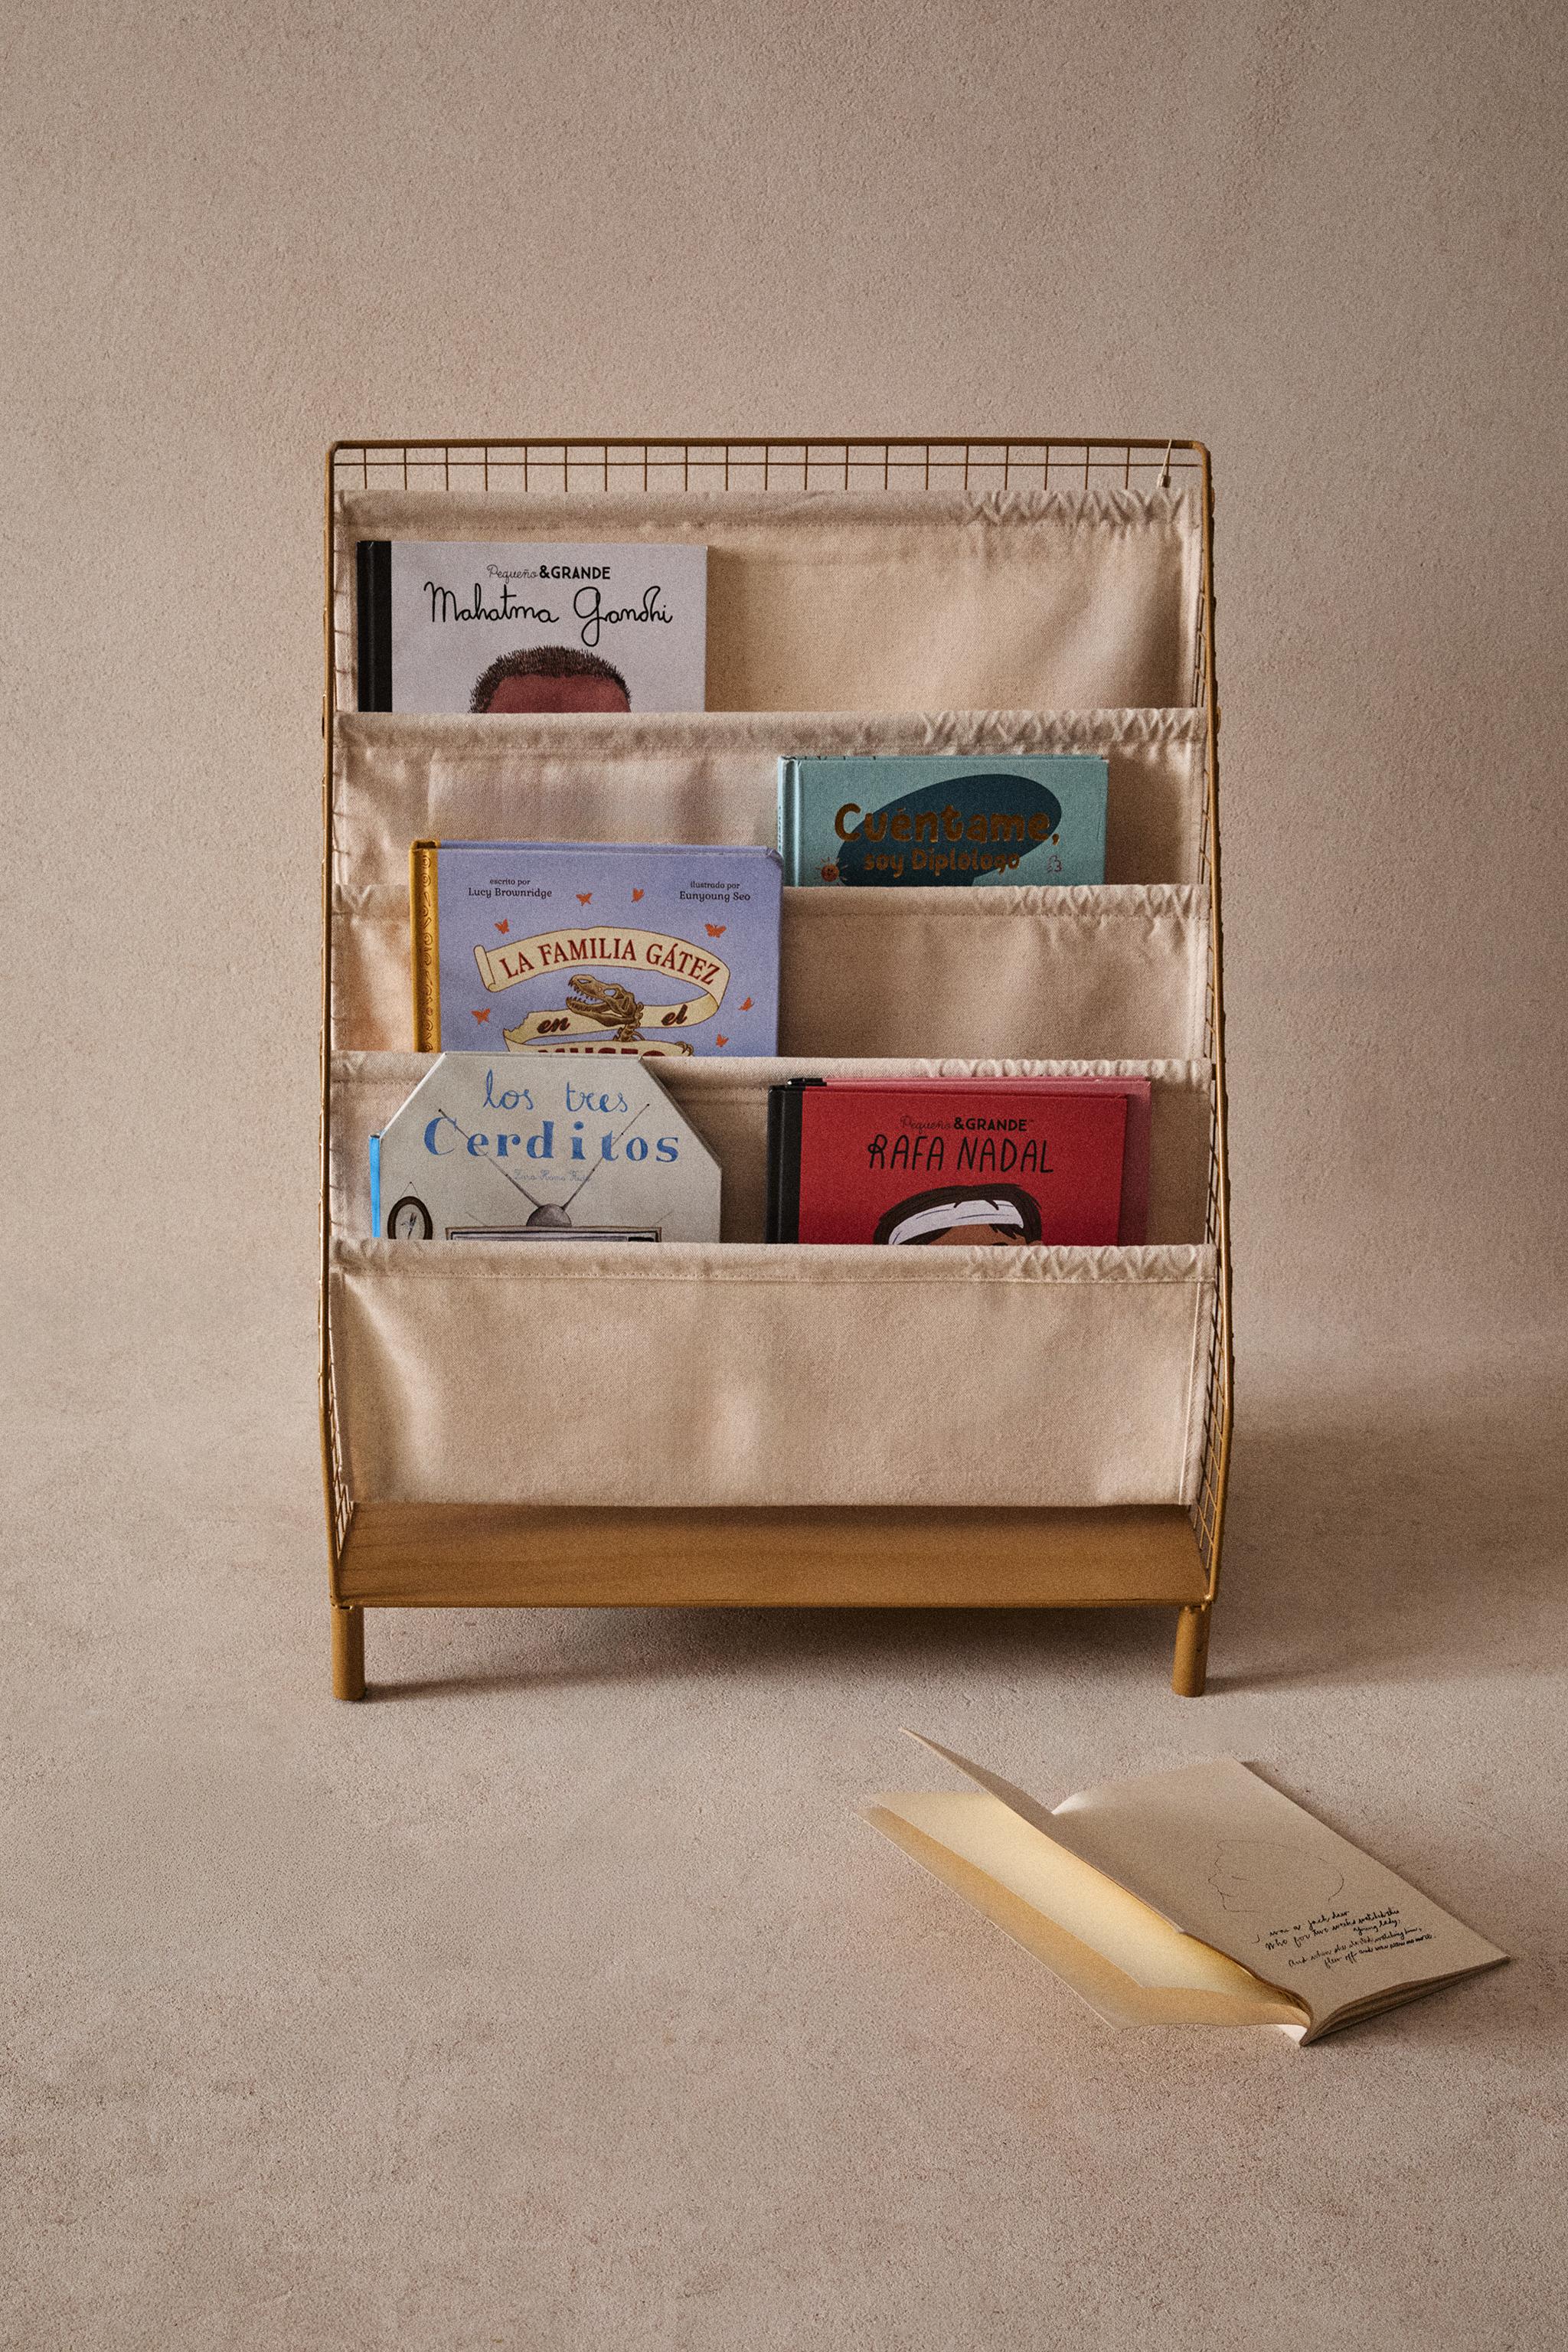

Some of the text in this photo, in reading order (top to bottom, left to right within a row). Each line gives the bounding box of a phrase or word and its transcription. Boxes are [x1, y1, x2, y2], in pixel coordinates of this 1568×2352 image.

[486, 564, 537, 584] Pequeño
[423, 581, 674, 647] Mahatma Gandhi
[835, 802, 1060, 846] Cuéntame,
[864, 853, 903, 878] soy
[468, 887, 553, 900] Lucy Brownridge
[517, 879, 531, 887] por
[679, 890, 751, 903] Eunyoung Seo
[690, 880, 740, 891] ilustrado por
[498, 938, 721, 985] LA FAMILIA GÁTEZ
[537, 1004, 688, 1034] en el
[482, 1069, 629, 1112] los tres
[423, 1116, 679, 1162] Cerditos
[867, 1133, 1054, 1173] RAFA NADAL
